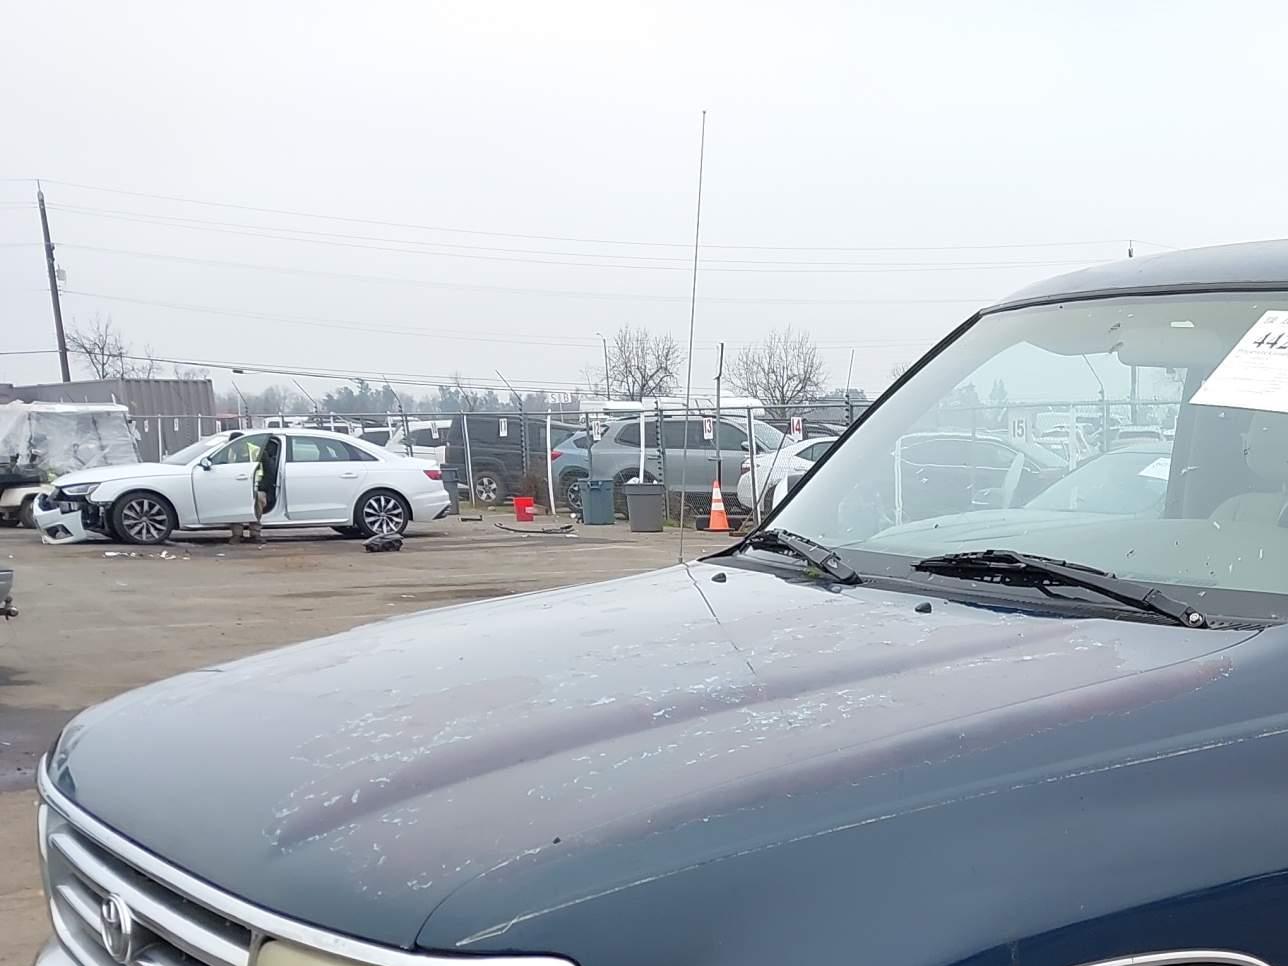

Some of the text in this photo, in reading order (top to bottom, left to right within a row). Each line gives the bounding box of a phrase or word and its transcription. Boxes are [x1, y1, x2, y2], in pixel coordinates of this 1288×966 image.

[704, 418, 713, 434] 13
[792, 419, 801, 434] 14
[1012, 419, 1025, 439] 15
